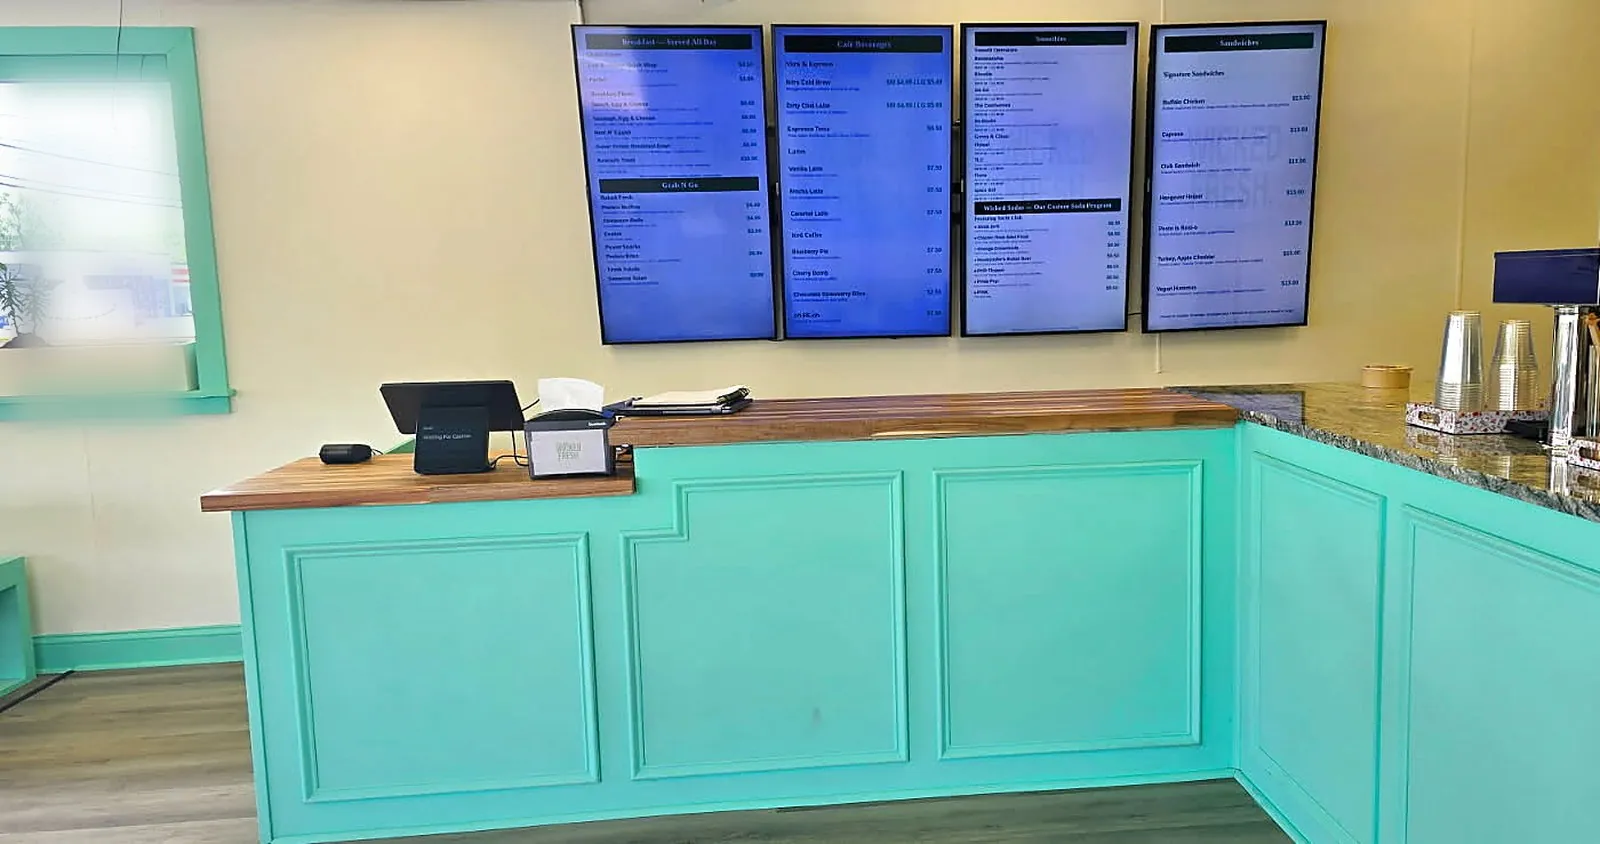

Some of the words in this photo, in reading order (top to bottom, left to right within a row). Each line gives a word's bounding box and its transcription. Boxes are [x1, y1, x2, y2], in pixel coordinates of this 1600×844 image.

[1219, 39, 1260, 47] Sandwiches
[662, 181, 680, 189] Grab
[984, 204, 1006, 212] Wicked
[1033, 203, 1046, 211] Our
